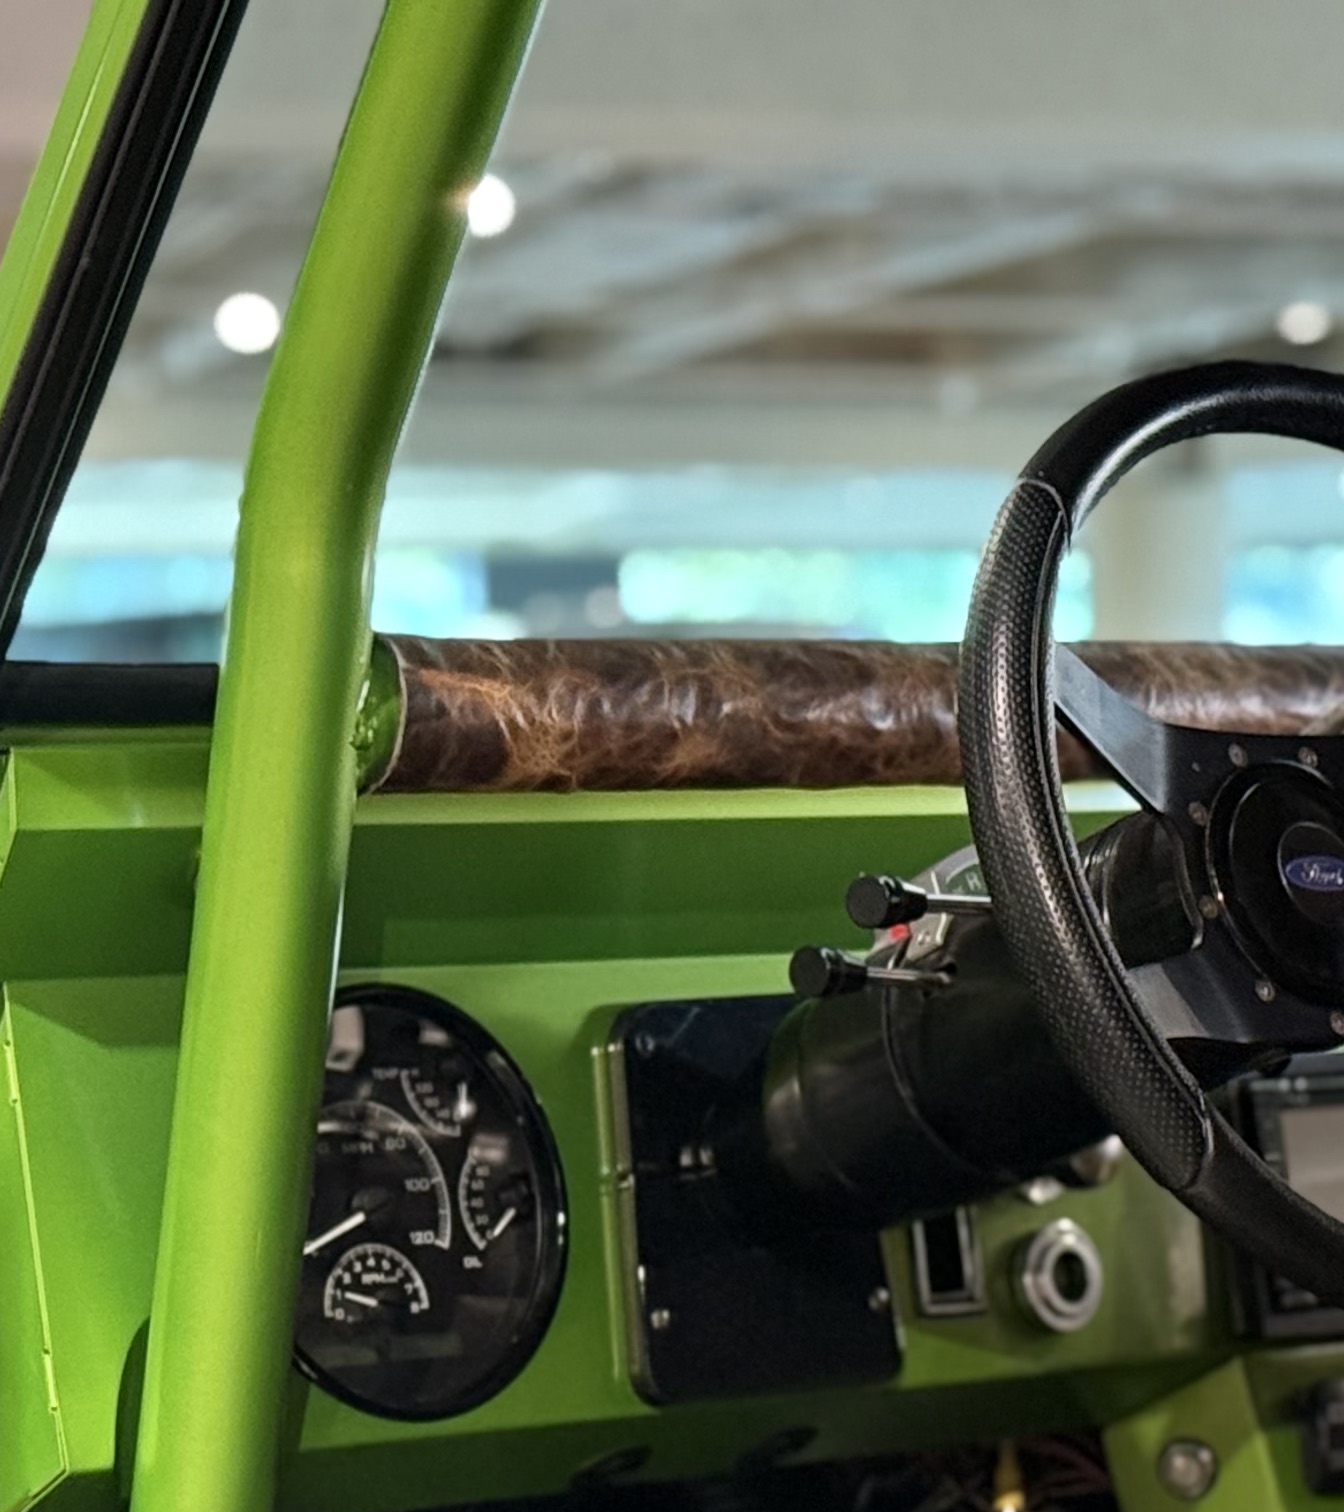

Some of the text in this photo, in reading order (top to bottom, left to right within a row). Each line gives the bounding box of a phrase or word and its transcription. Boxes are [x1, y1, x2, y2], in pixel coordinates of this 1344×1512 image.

[1300, 862, 1344, 886] Ford
[404, 1178, 430, 1192] 100
[409, 1231, 435, 1246] 120
